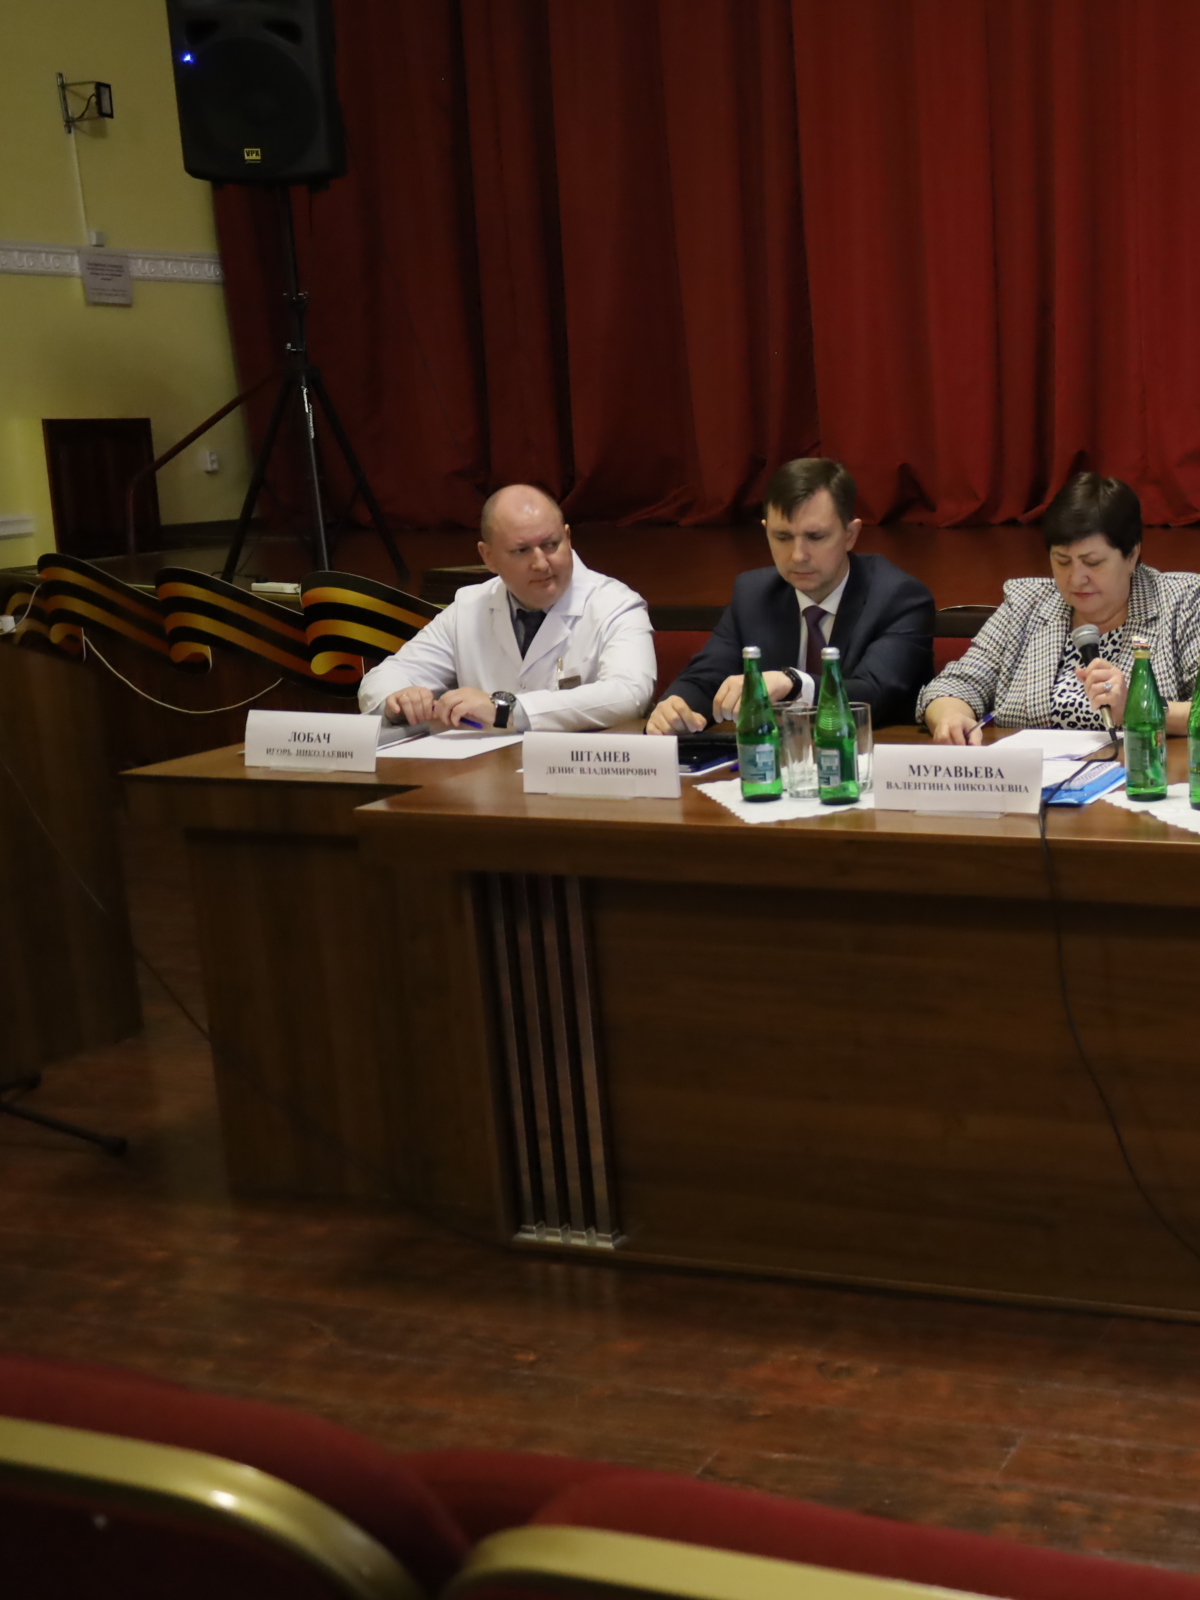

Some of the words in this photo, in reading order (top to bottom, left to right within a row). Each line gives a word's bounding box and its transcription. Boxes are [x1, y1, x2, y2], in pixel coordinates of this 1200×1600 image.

[288, 731, 331, 744] ЛОБАЧ
[266, 748, 292, 756] ИГОРЬ
[295, 748, 354, 759] НИКОЛАЕВИЧ
[570, 750, 631, 763] ШТАНЕВ
[546, 766, 577, 775] ДЕНИС
[579, 767, 657, 776] ВЛАДИМИРОВИЧ
[908, 764, 1005, 779] МУРАВЬЕВА
[886, 781, 951, 791] ВАЛЕНТИНА
[954, 783, 1029, 793] НИКОЛАЕВНА
